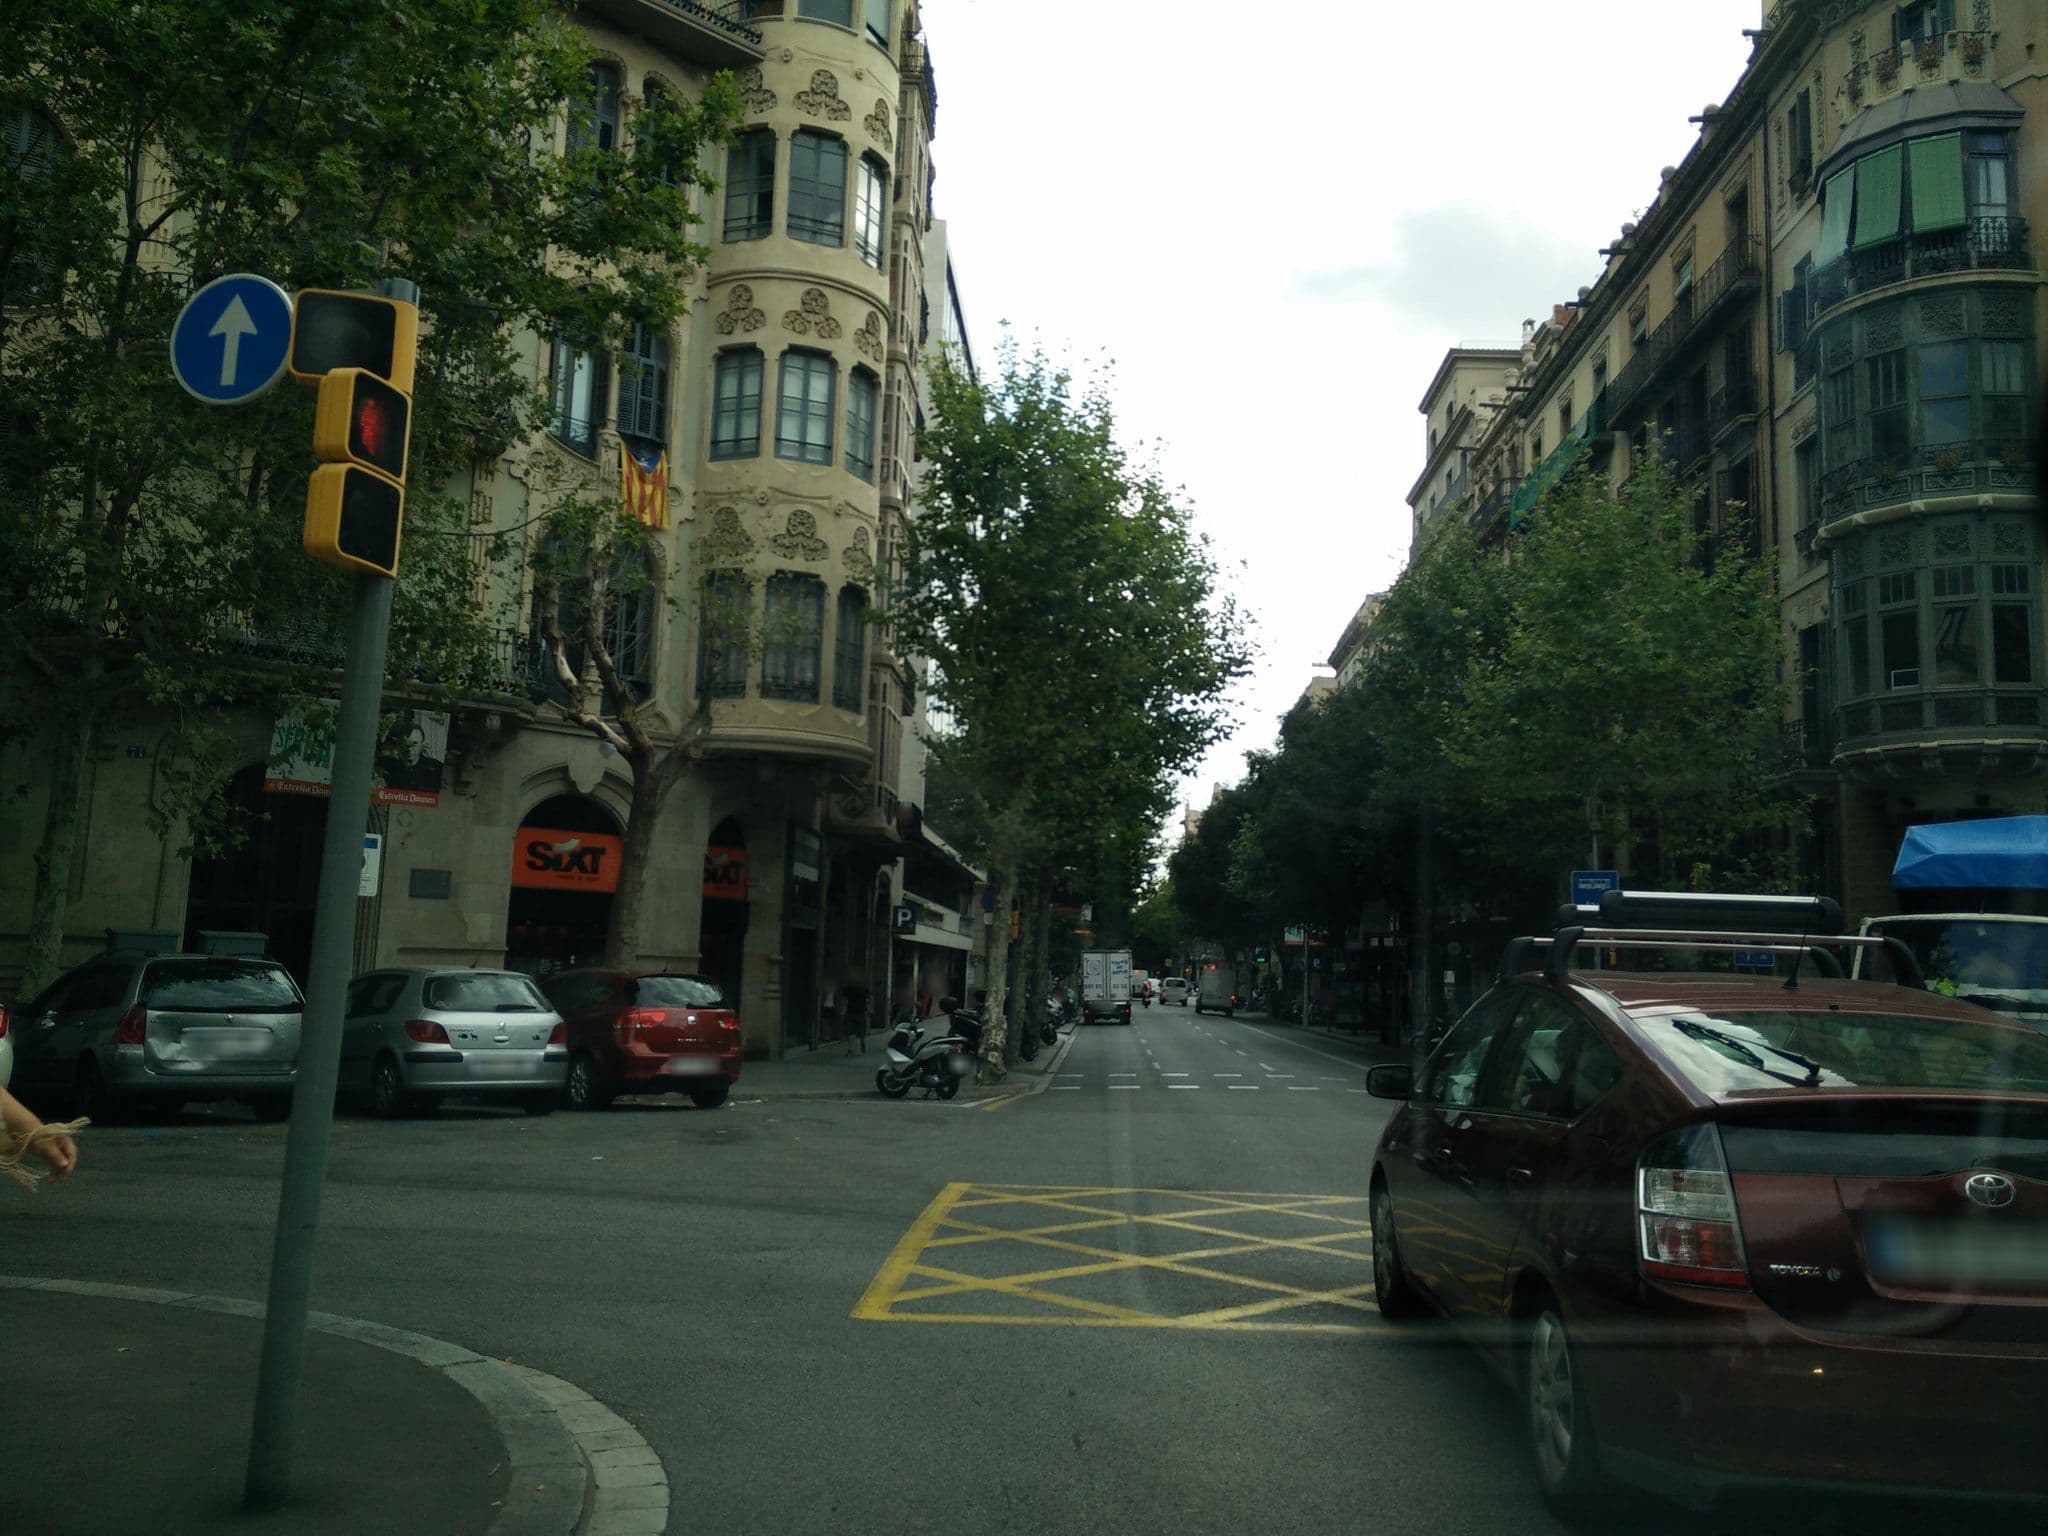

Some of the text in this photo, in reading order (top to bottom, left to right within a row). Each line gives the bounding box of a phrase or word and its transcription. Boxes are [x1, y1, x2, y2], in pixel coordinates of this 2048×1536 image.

[276, 782, 311, 793] Estrella
[378, 791, 436, 805] Estrella Damm
[896, 908, 912, 928] P
[1768, 1264, 1821, 1278] TOYOTA
